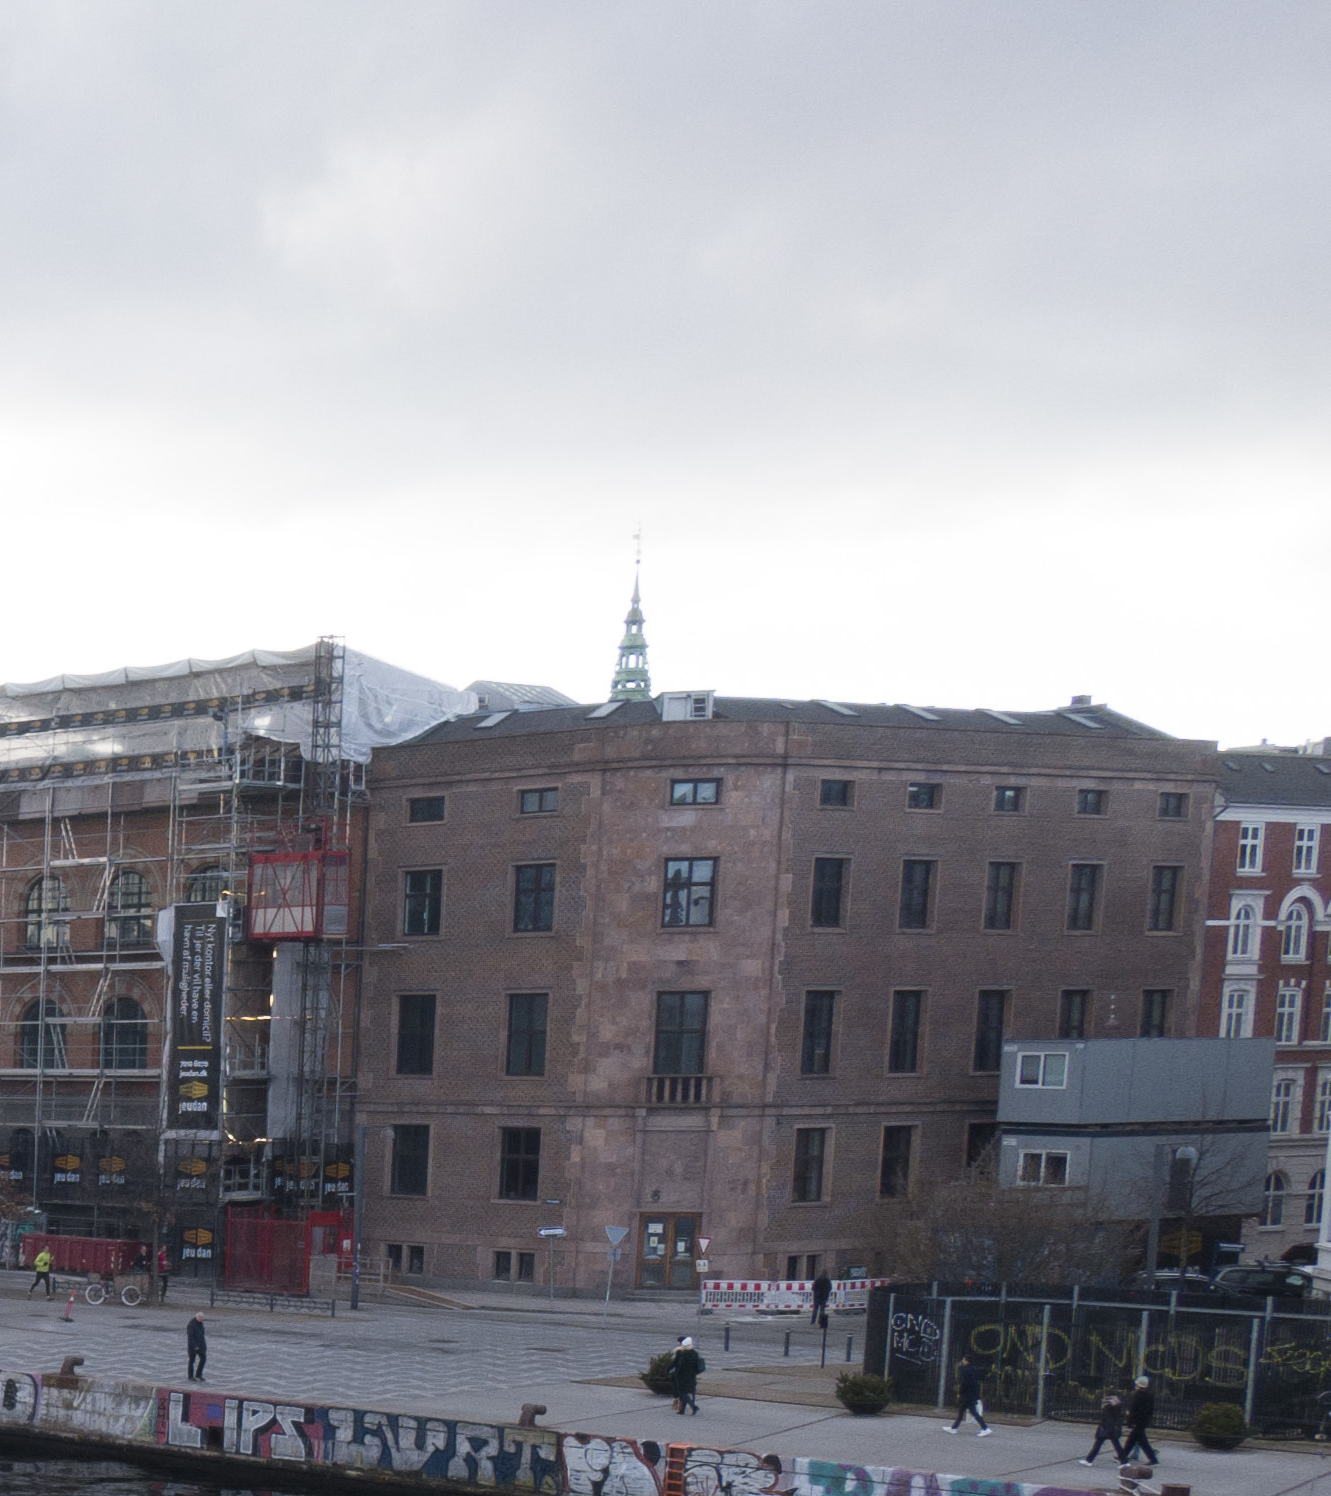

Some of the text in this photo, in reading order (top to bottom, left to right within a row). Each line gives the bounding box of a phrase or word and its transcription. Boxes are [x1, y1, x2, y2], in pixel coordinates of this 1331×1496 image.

[195, 924, 205, 936] Til
[193, 955, 203, 971] der
[192, 973, 202, 985] vil
[202, 924, 216, 1042] Nyt kontor eller domicil?
[191, 985, 202, 1009] have
